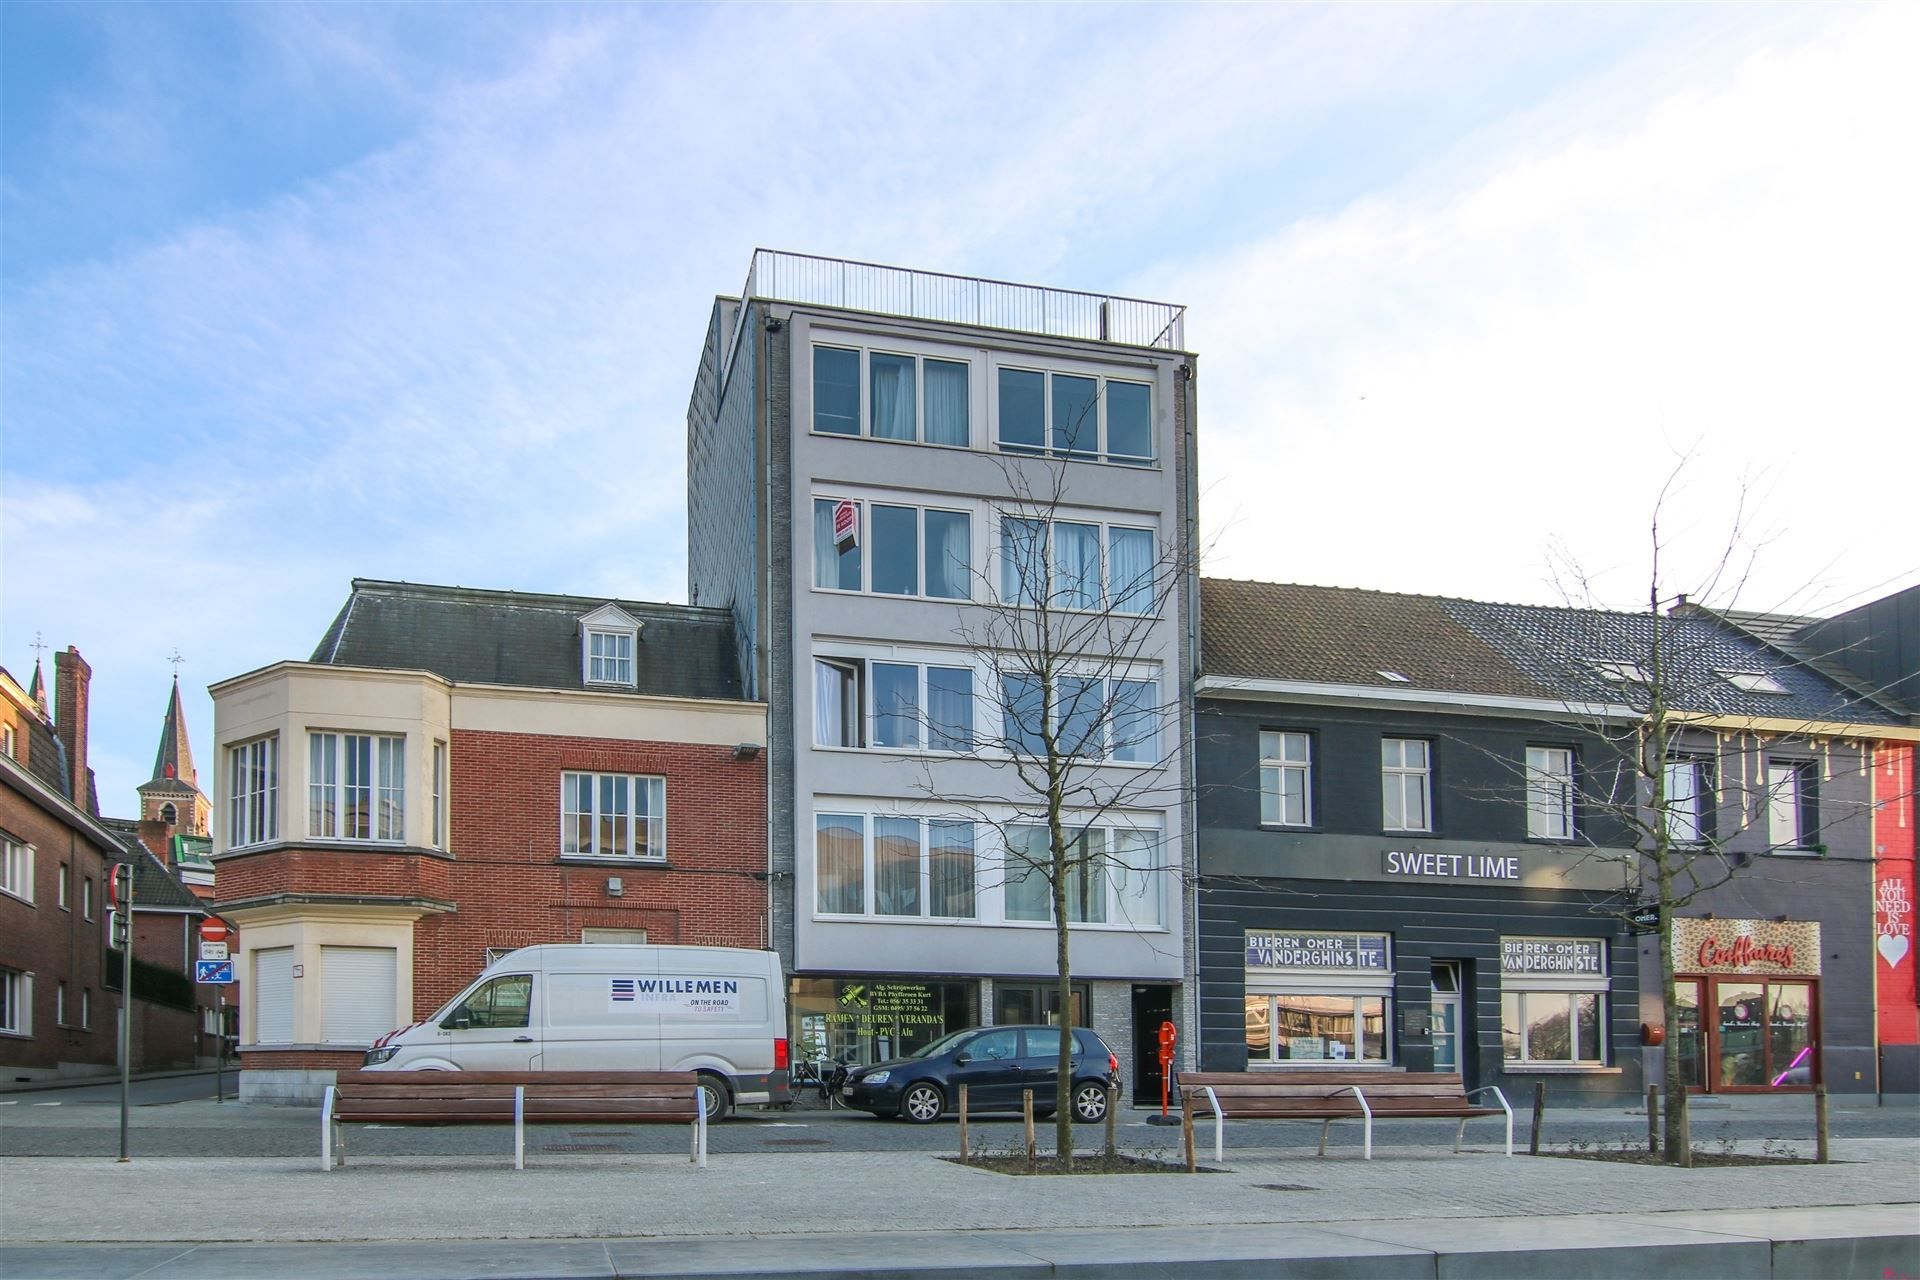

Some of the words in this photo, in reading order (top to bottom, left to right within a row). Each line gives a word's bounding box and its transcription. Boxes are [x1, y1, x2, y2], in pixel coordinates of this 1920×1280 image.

[1387, 851, 1463, 877] SWEET
[1467, 855, 1519, 879] LIME
[1879, 889, 1907, 901] YOU
[1876, 900, 1911, 913] NEED
[1877, 923, 1911, 935] LOVE
[1249, 936, 1300, 948] BIEREN
[1306, 938, 1343, 949] OMER
[1501, 954, 1598, 971] VANDERGHINSTE
[637, 979, 737, 994] WILLEMEN
[641, 993, 676, 1002] INFRA
[702, 1005, 724, 1013] SAFETY
[825, 1013, 854, 1024] RAMEN
[861, 1014, 894, 1024] DEUREN
[900, 1014, 944, 1025] VERANDA'S
[857, 1027, 874, 1037] Hout
[879, 1027, 896, 1037] PVC
[901, 1027, 913, 1037] Alu
